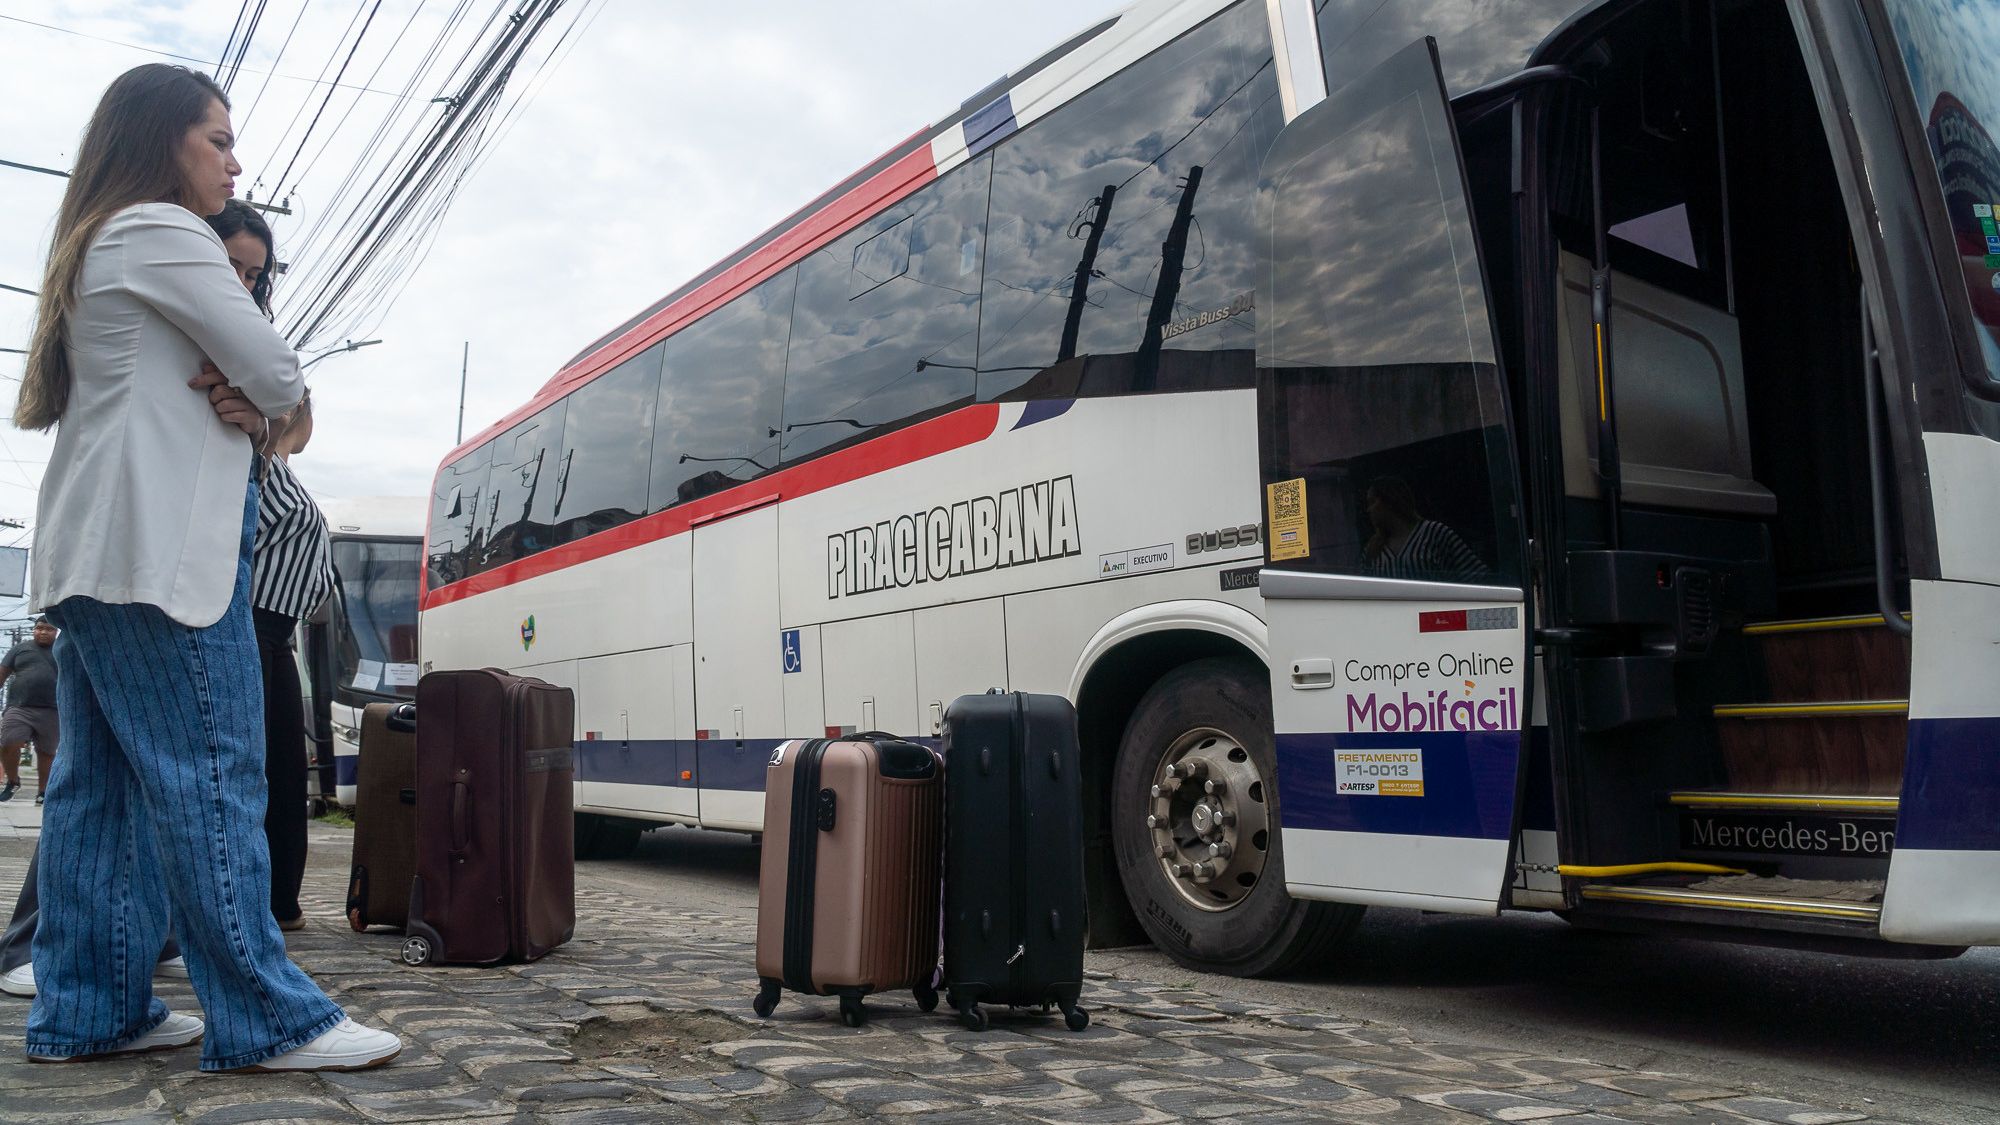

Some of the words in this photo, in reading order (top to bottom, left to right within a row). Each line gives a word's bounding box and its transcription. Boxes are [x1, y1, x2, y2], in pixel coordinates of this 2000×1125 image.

[1161, 317, 1197, 340] Vissta
[1200, 306, 1230, 327] Buss
[828, 474, 1082, 599] PIRACICABANA
[1133, 552, 1168, 566] EXECUTIVO
[1111, 562, 1126, 571] ANTT
[1345, 659, 1430, 687] Compre
[1438, 652, 1514, 677] Online
[1338, 754, 1418, 762] FRETAMENTO
[1347, 765, 1409, 776] F1-0013
[1347, 783, 1375, 791] ARTESP
